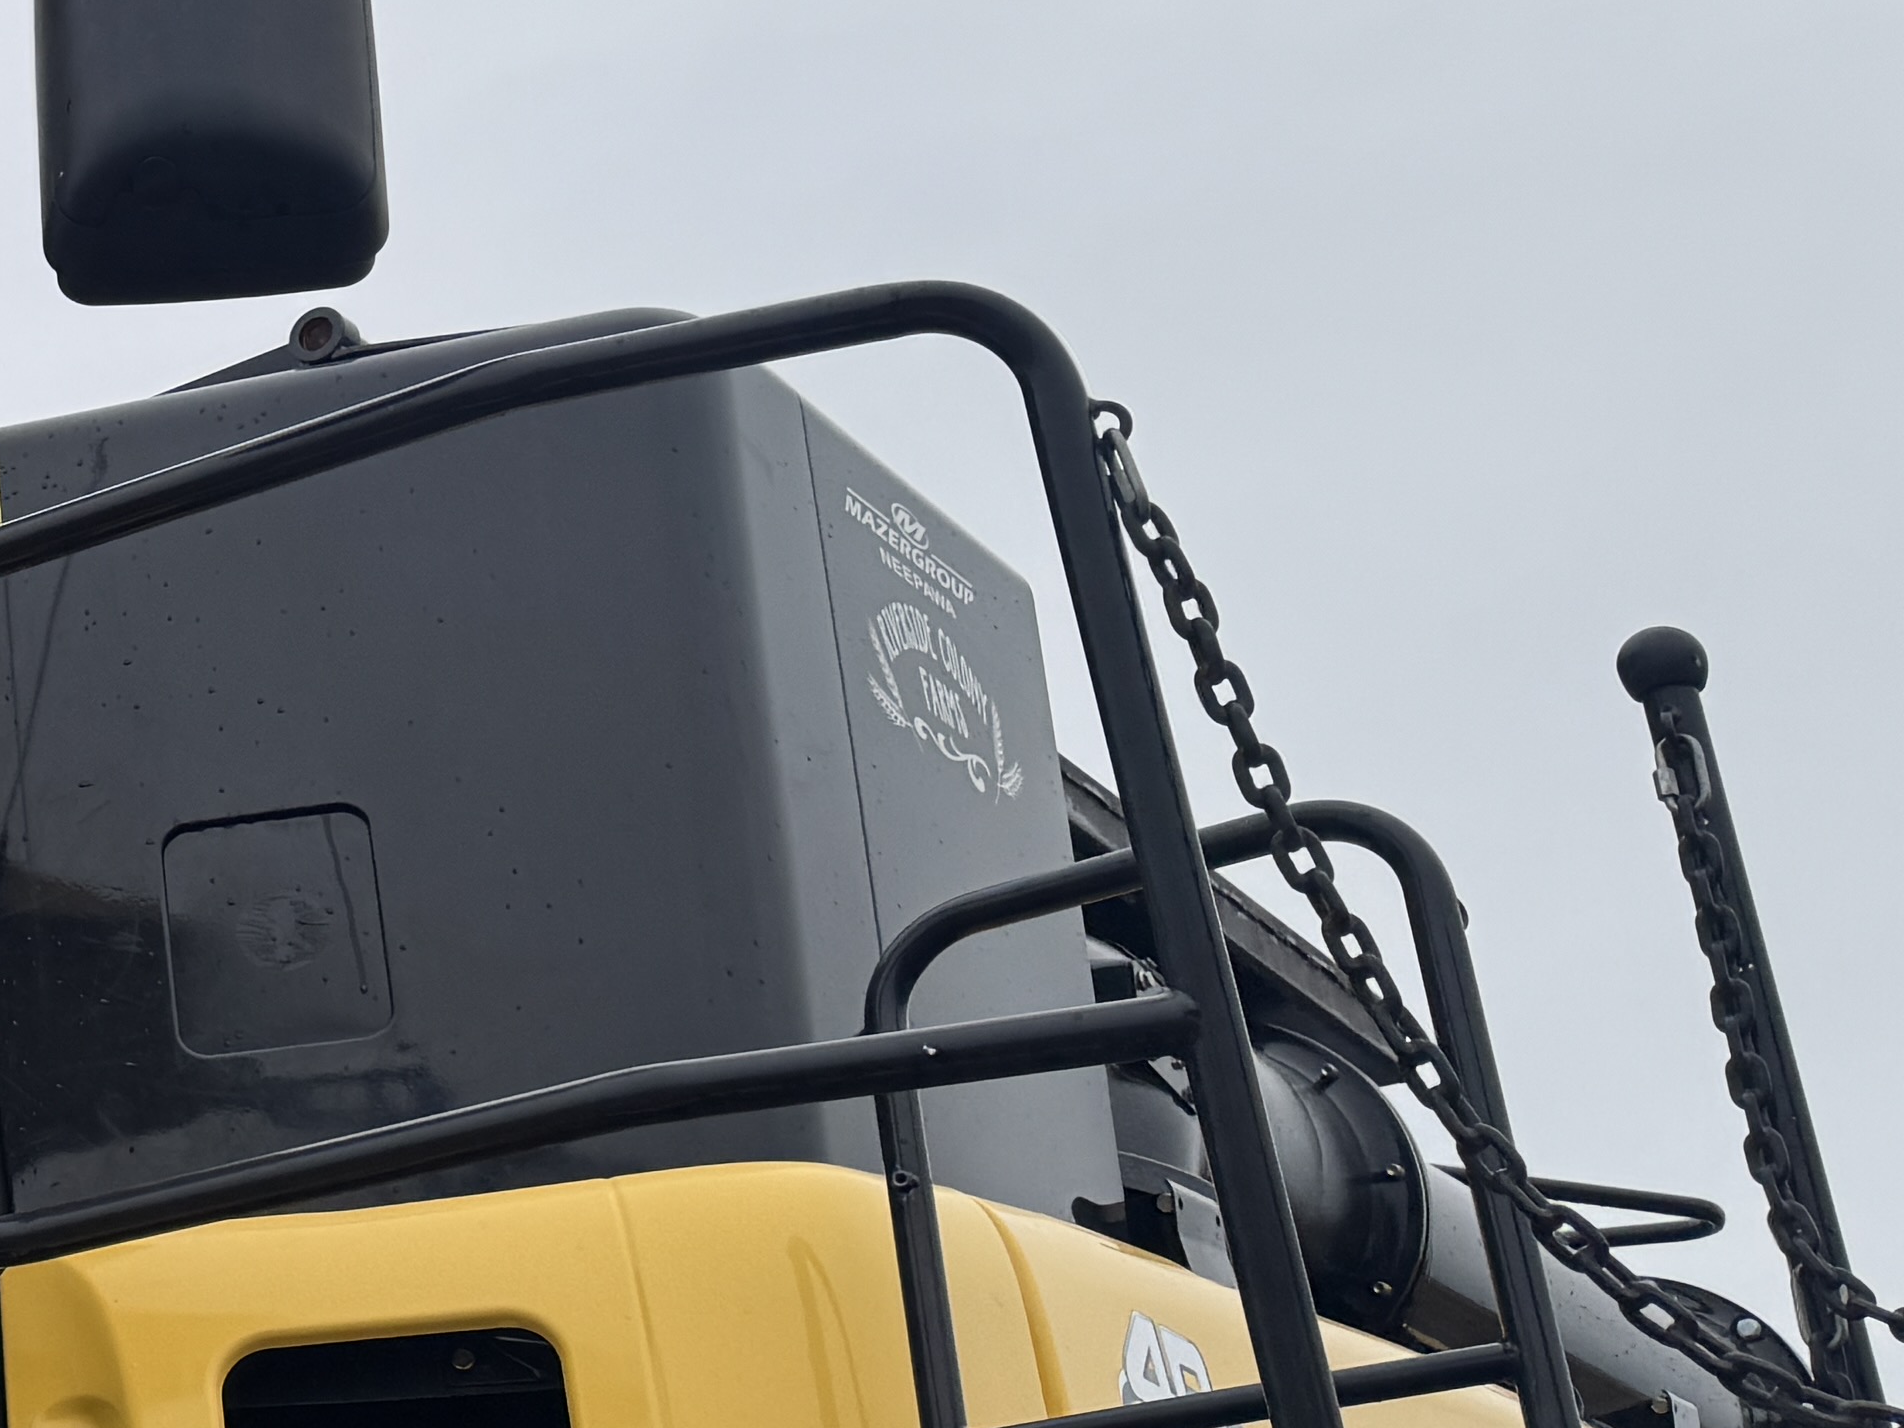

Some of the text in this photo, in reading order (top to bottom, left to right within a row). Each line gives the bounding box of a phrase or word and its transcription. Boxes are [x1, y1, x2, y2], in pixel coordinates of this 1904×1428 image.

[845, 494, 974, 605] MAZERGROUP
[879, 546, 957, 619] NEEPAWA
[877, 602, 988, 725] RIVERSIDE COLONY
[919, 666, 969, 739] FARMS
